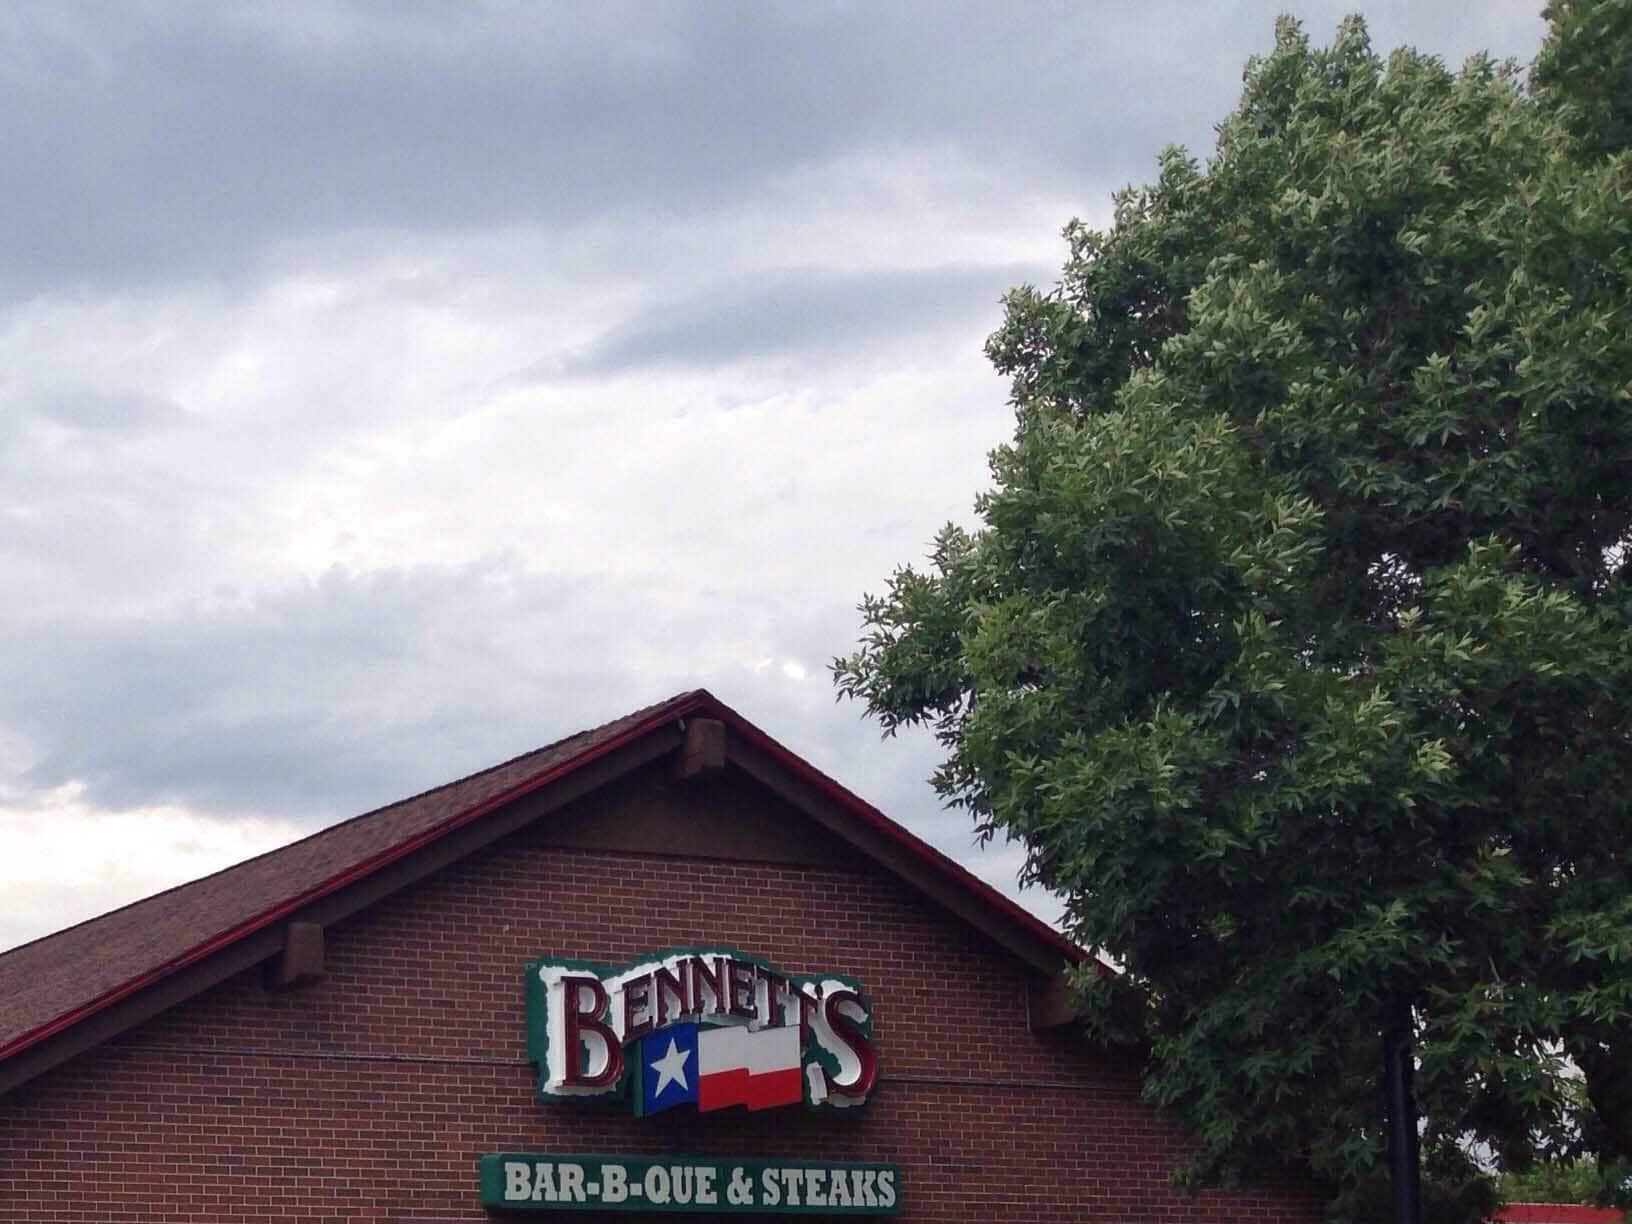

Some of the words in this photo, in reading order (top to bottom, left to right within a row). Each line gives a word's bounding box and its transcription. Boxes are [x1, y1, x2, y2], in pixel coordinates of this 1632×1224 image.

[556, 954, 878, 1098] BENNETT'S
[504, 1161, 718, 1207] BAR-B-QUE
[727, 1167, 754, 1206] &
[762, 1168, 897, 1208] STEAKS
